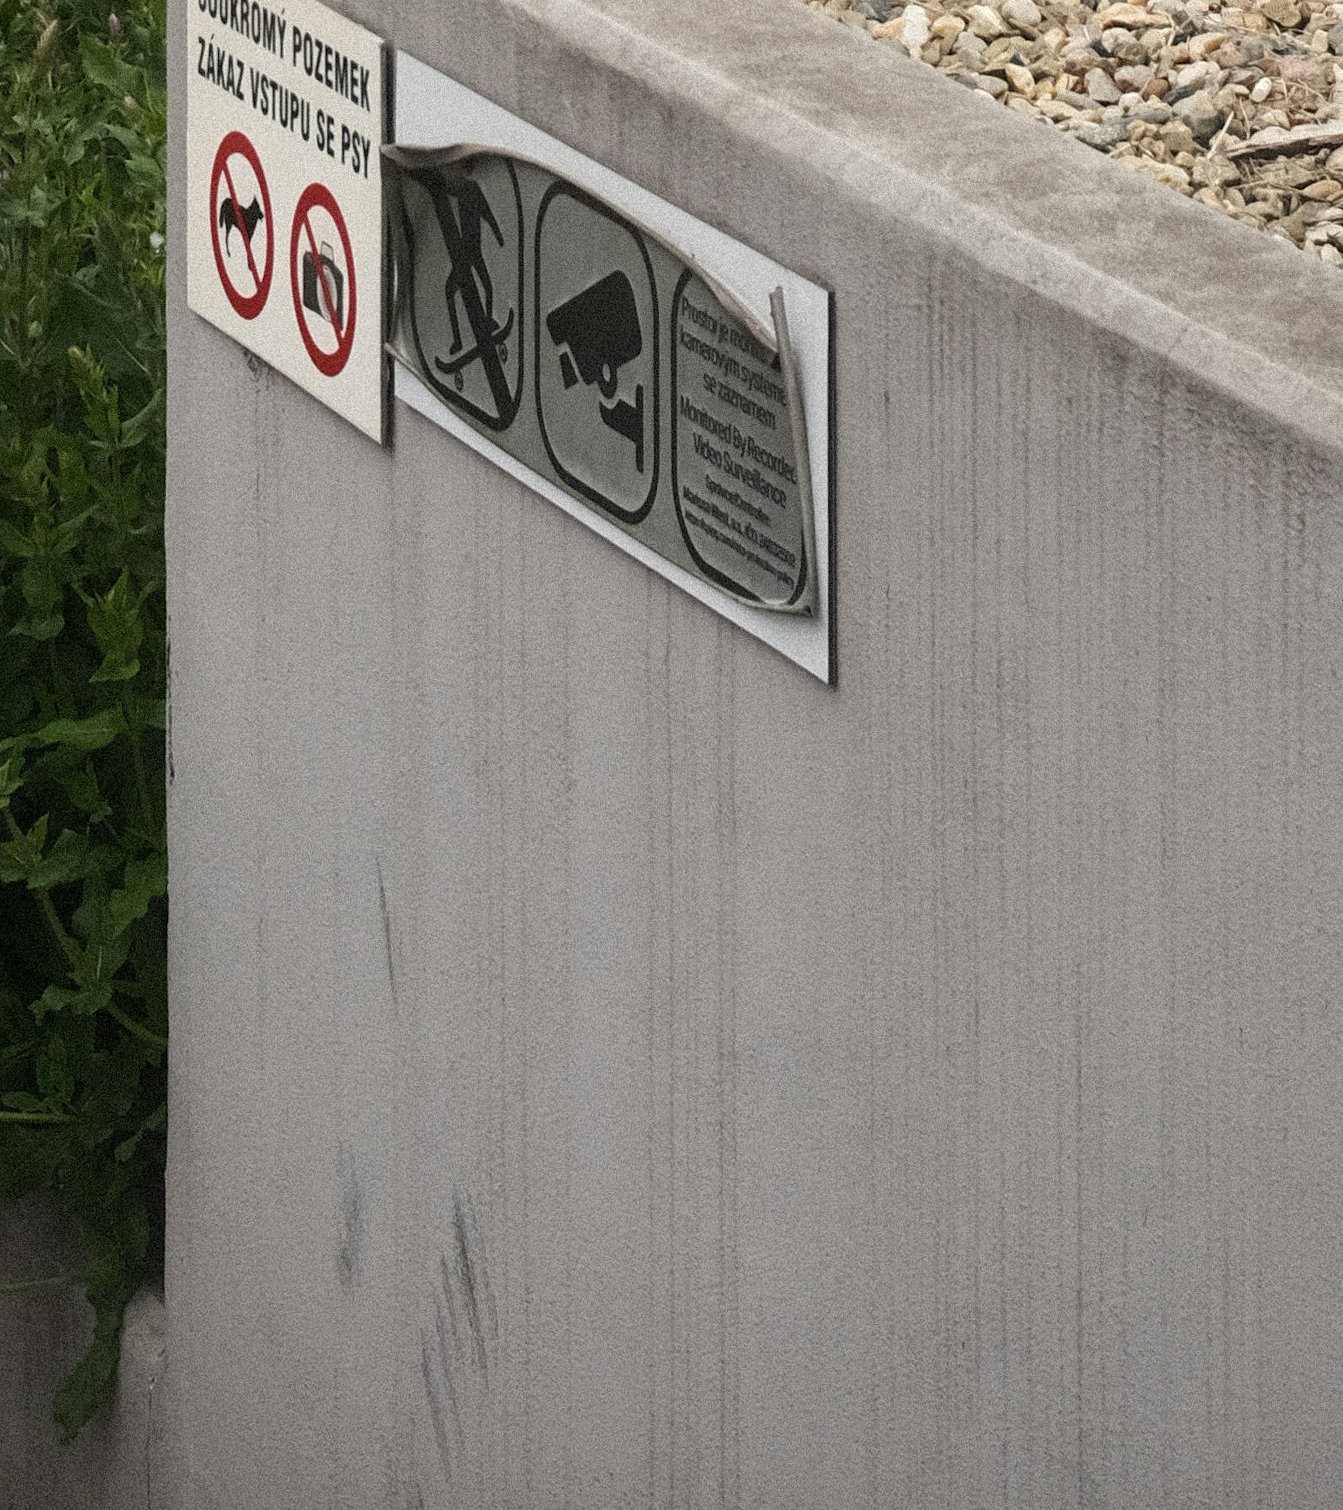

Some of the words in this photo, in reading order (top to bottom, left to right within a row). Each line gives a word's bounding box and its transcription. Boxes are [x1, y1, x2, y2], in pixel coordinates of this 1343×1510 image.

[198, 33, 245, 102] ZÁKAZ
[250, 67, 311, 143] VSTUPU
[316, 108, 336, 159] SE
[341, 123, 371, 180] PSY
[292, 25, 371, 113] POZEMEK
[680, 395, 732, 445] Monitored
[733, 426, 746, 458] By
[693, 432, 723, 470] Video
